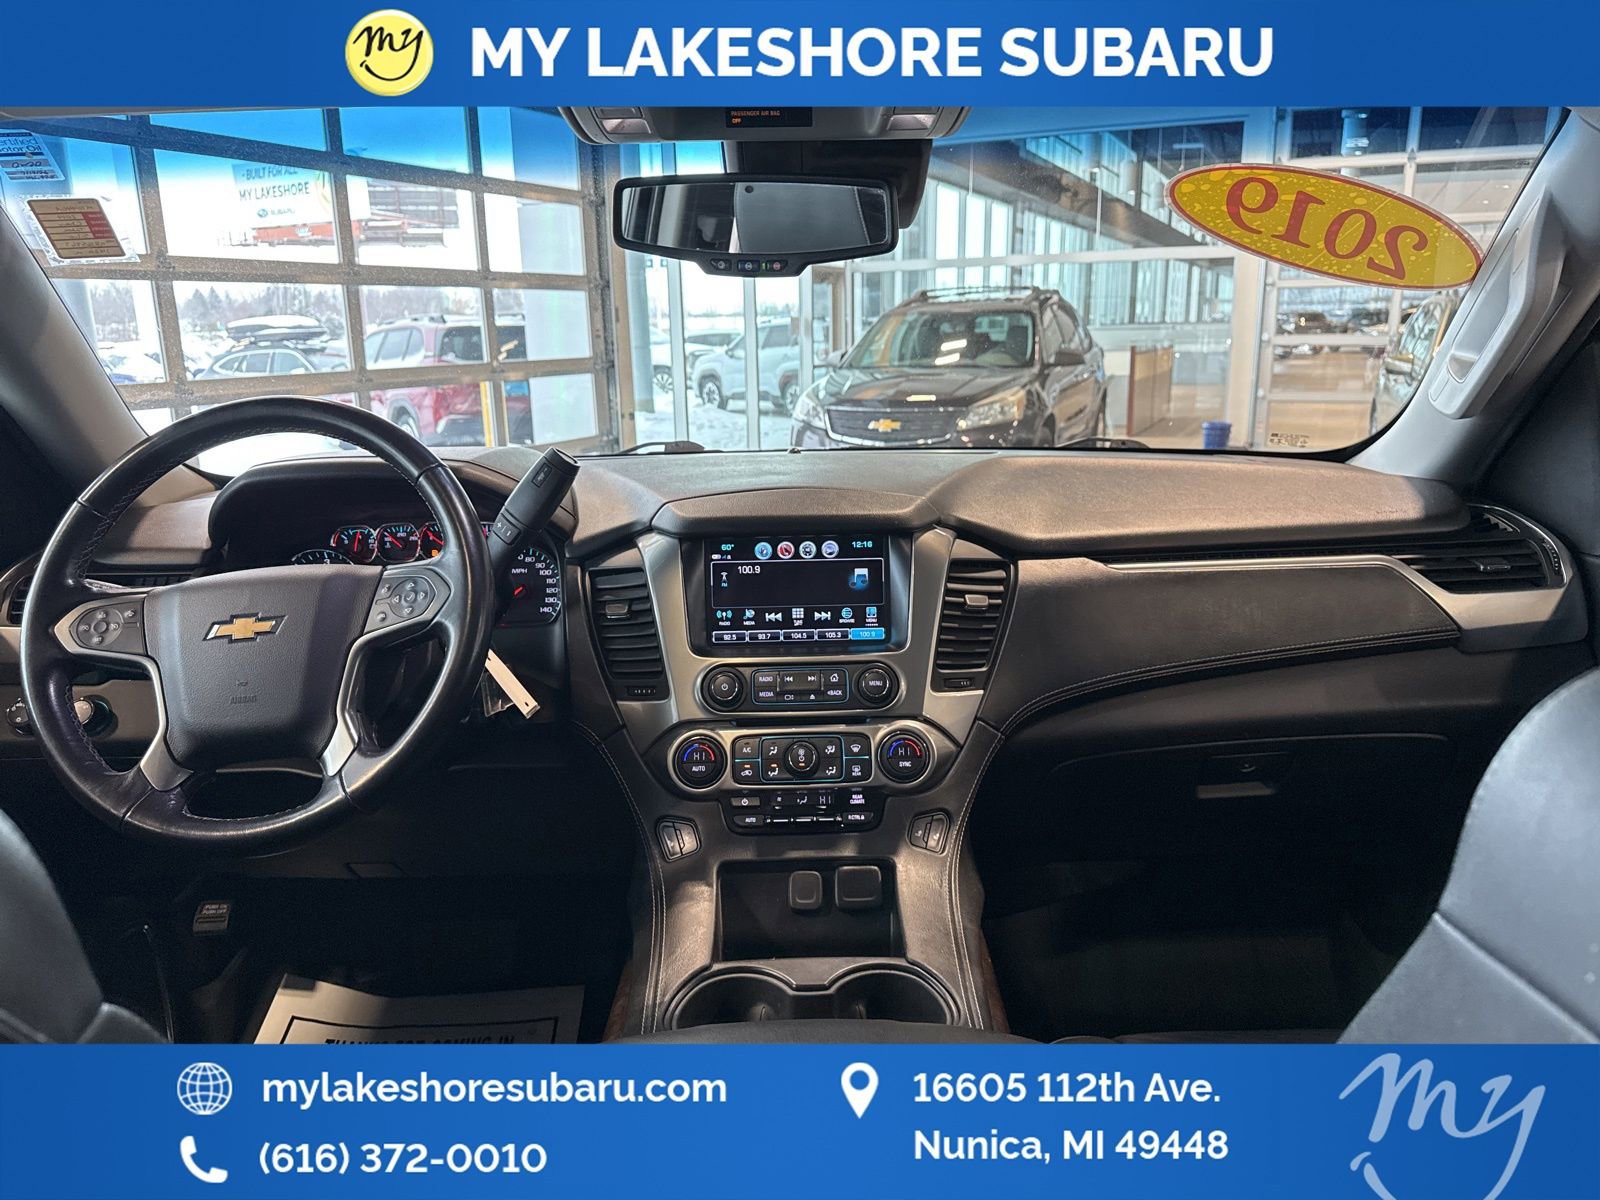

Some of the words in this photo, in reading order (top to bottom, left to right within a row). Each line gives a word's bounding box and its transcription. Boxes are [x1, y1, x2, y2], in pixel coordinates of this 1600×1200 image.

[239, 189, 252, 201] MY
[254, 182, 310, 200] LAKESHORE
[738, 565, 761, 575] 100.9
[723, 633, 737, 641] 92.5
